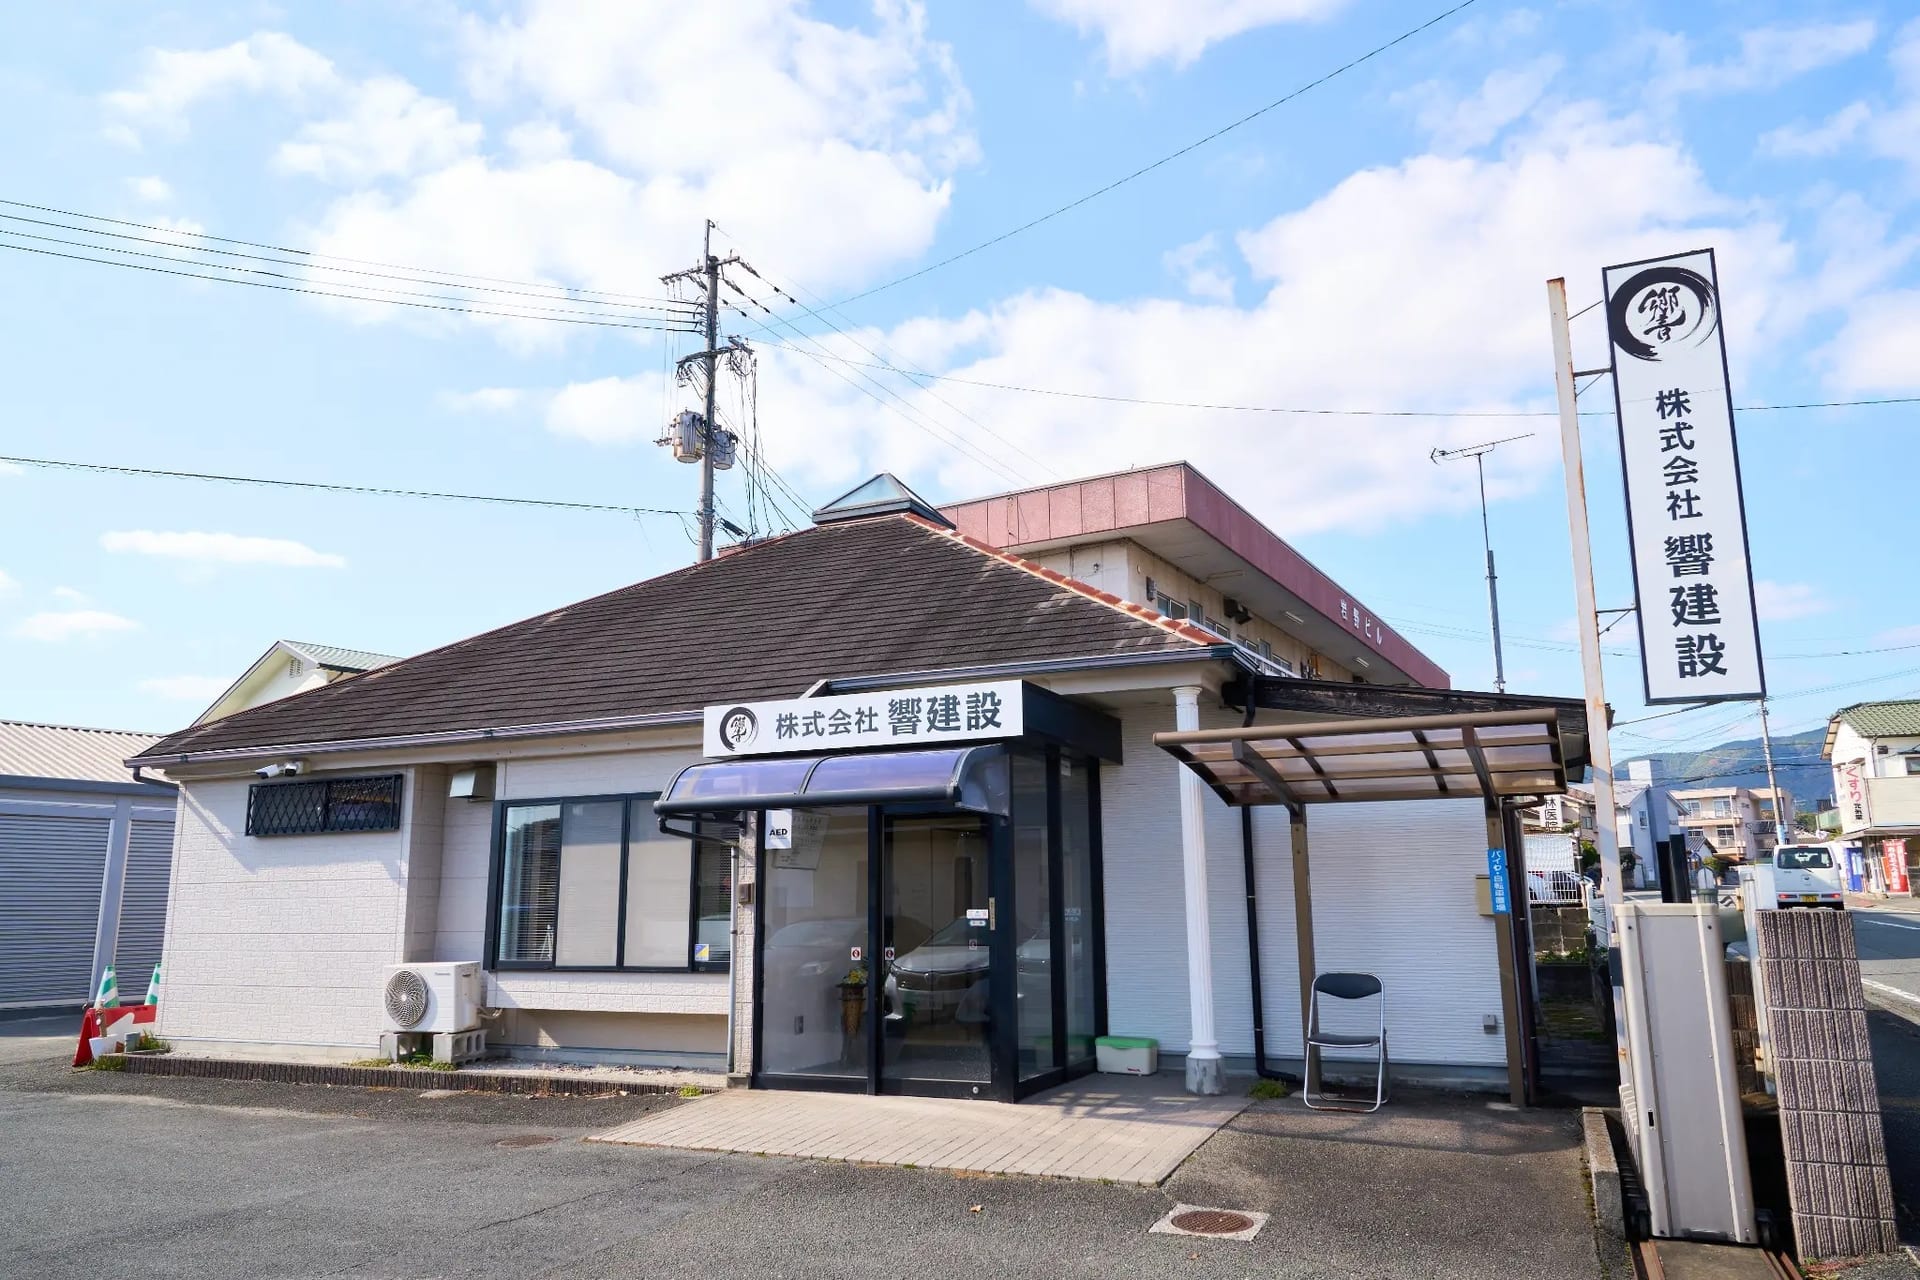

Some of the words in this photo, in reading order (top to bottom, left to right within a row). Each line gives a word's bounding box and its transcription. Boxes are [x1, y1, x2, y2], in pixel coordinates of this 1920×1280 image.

[1655, 387, 1704, 521] 株式会社
[1664, 532, 1728, 679] 響建設
[775, 706, 879, 740] 株式会社
[887, 690, 1002, 737] 響建設
[1846, 765, 1862, 802] くすり
[769, 828, 788, 836] AED
